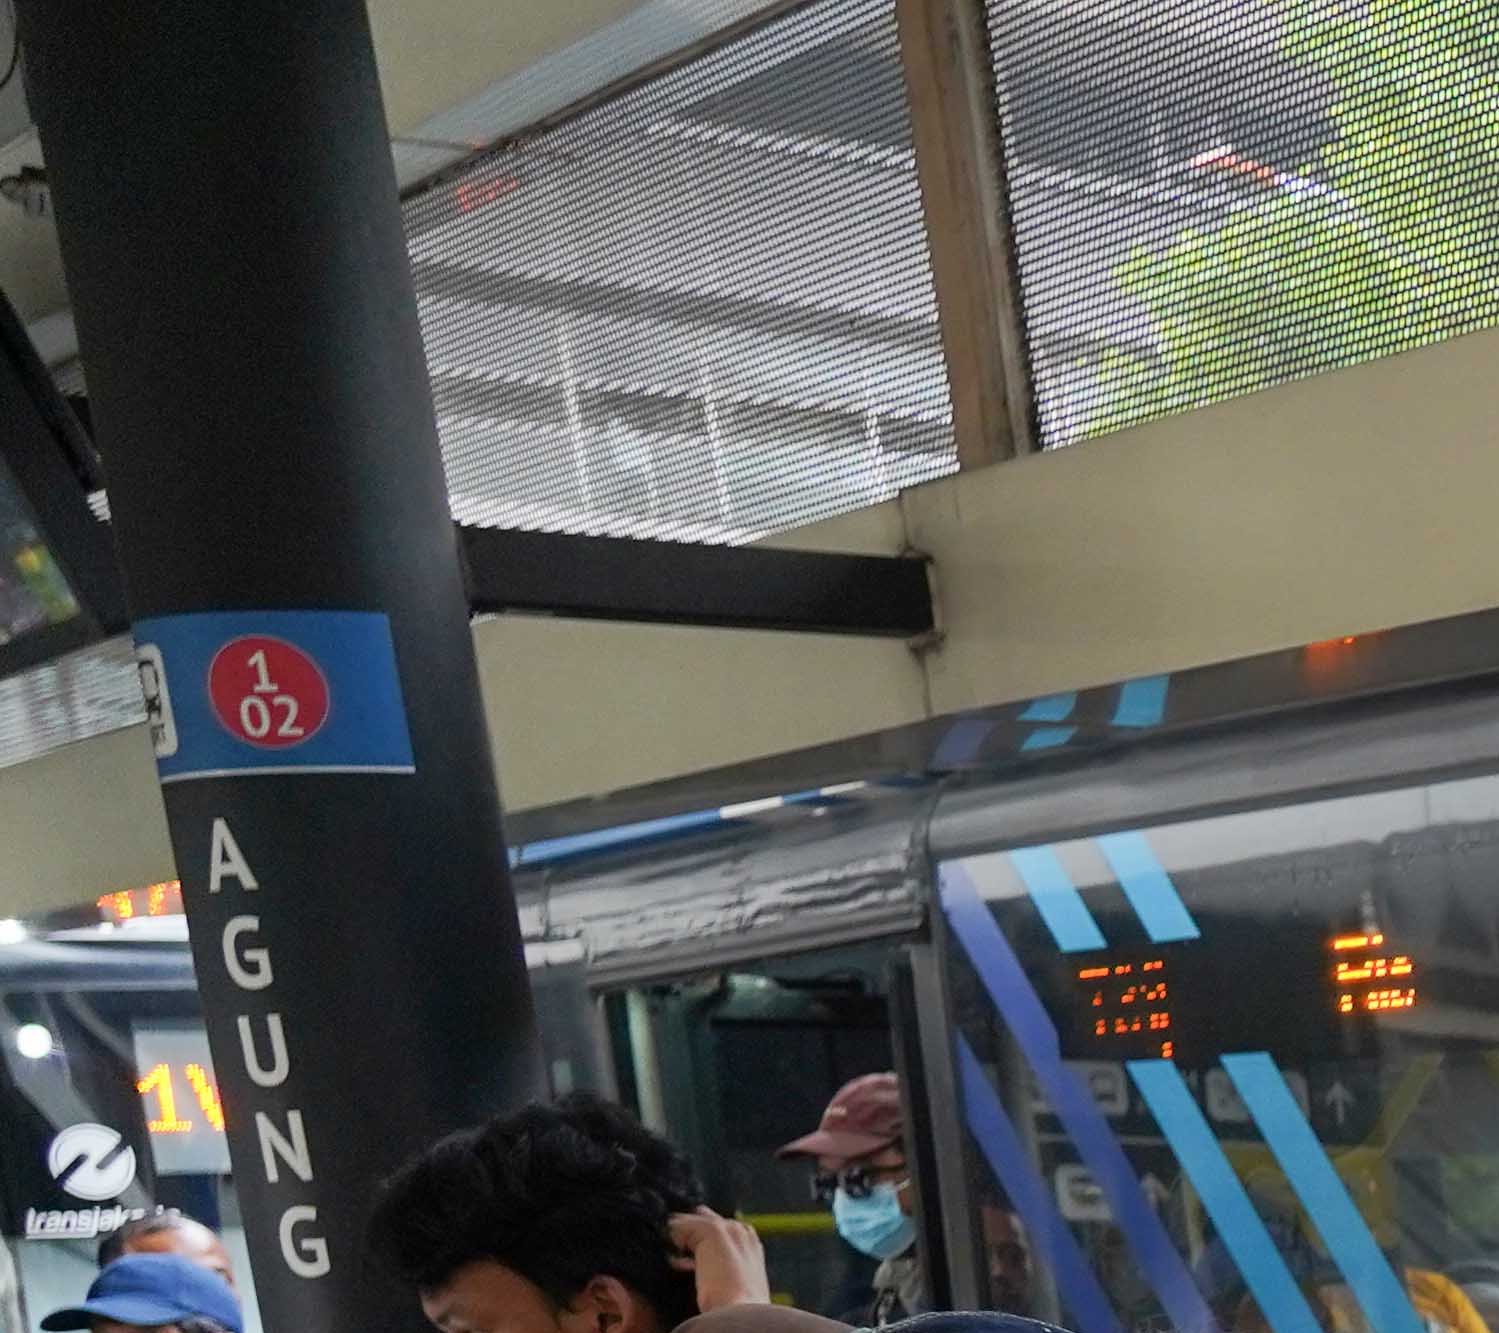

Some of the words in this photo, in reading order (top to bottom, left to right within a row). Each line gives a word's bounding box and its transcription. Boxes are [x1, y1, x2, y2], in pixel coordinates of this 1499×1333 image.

[247, 650, 278, 692] 1
[239, 697, 305, 738] 02
[209, 817, 331, 1278] AGUNG
